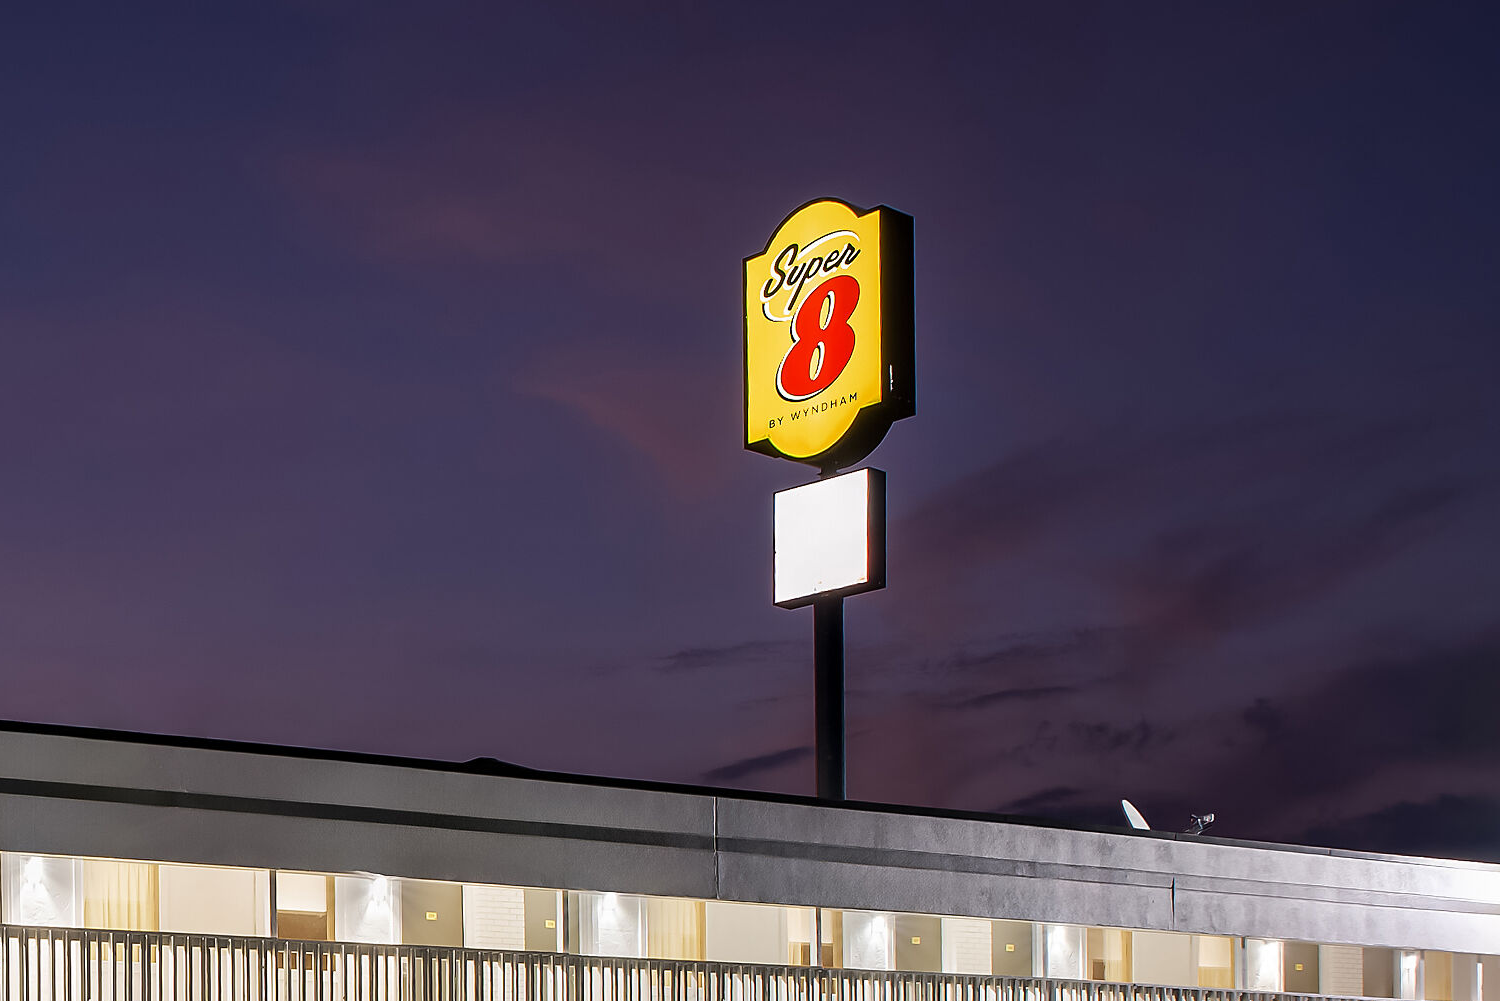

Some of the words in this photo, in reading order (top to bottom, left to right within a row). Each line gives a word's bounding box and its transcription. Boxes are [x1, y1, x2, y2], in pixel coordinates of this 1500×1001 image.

[762, 243, 861, 313] Super
[776, 274, 860, 402] 8
[768, 416, 784, 429] BY
[790, 392, 858, 421] WYNDHAM
